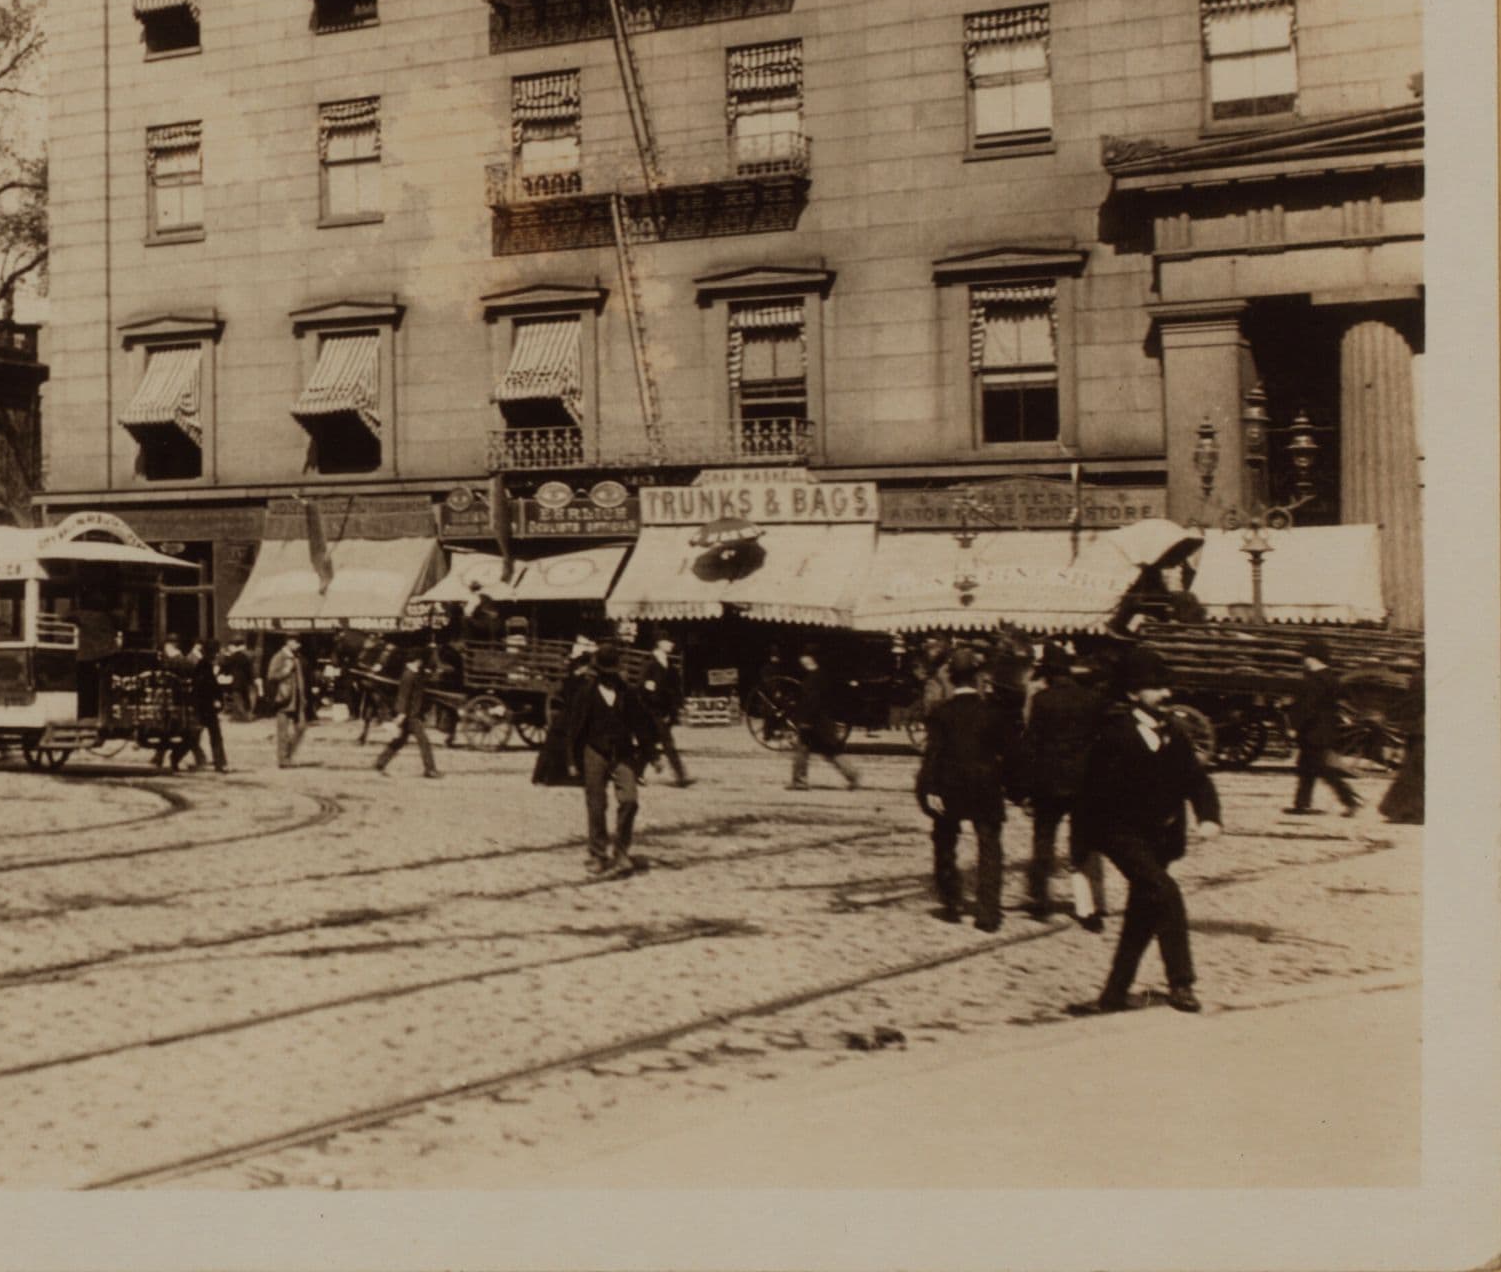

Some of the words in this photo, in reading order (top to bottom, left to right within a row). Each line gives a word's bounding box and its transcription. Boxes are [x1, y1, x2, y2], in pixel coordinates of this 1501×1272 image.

[644, 487, 752, 521] TRUNKS
[762, 486, 781, 518] &
[791, 485, 870, 518] BAGS
[889, 506, 948, 521] ASTOR
[1084, 503, 1154, 521] STORE
